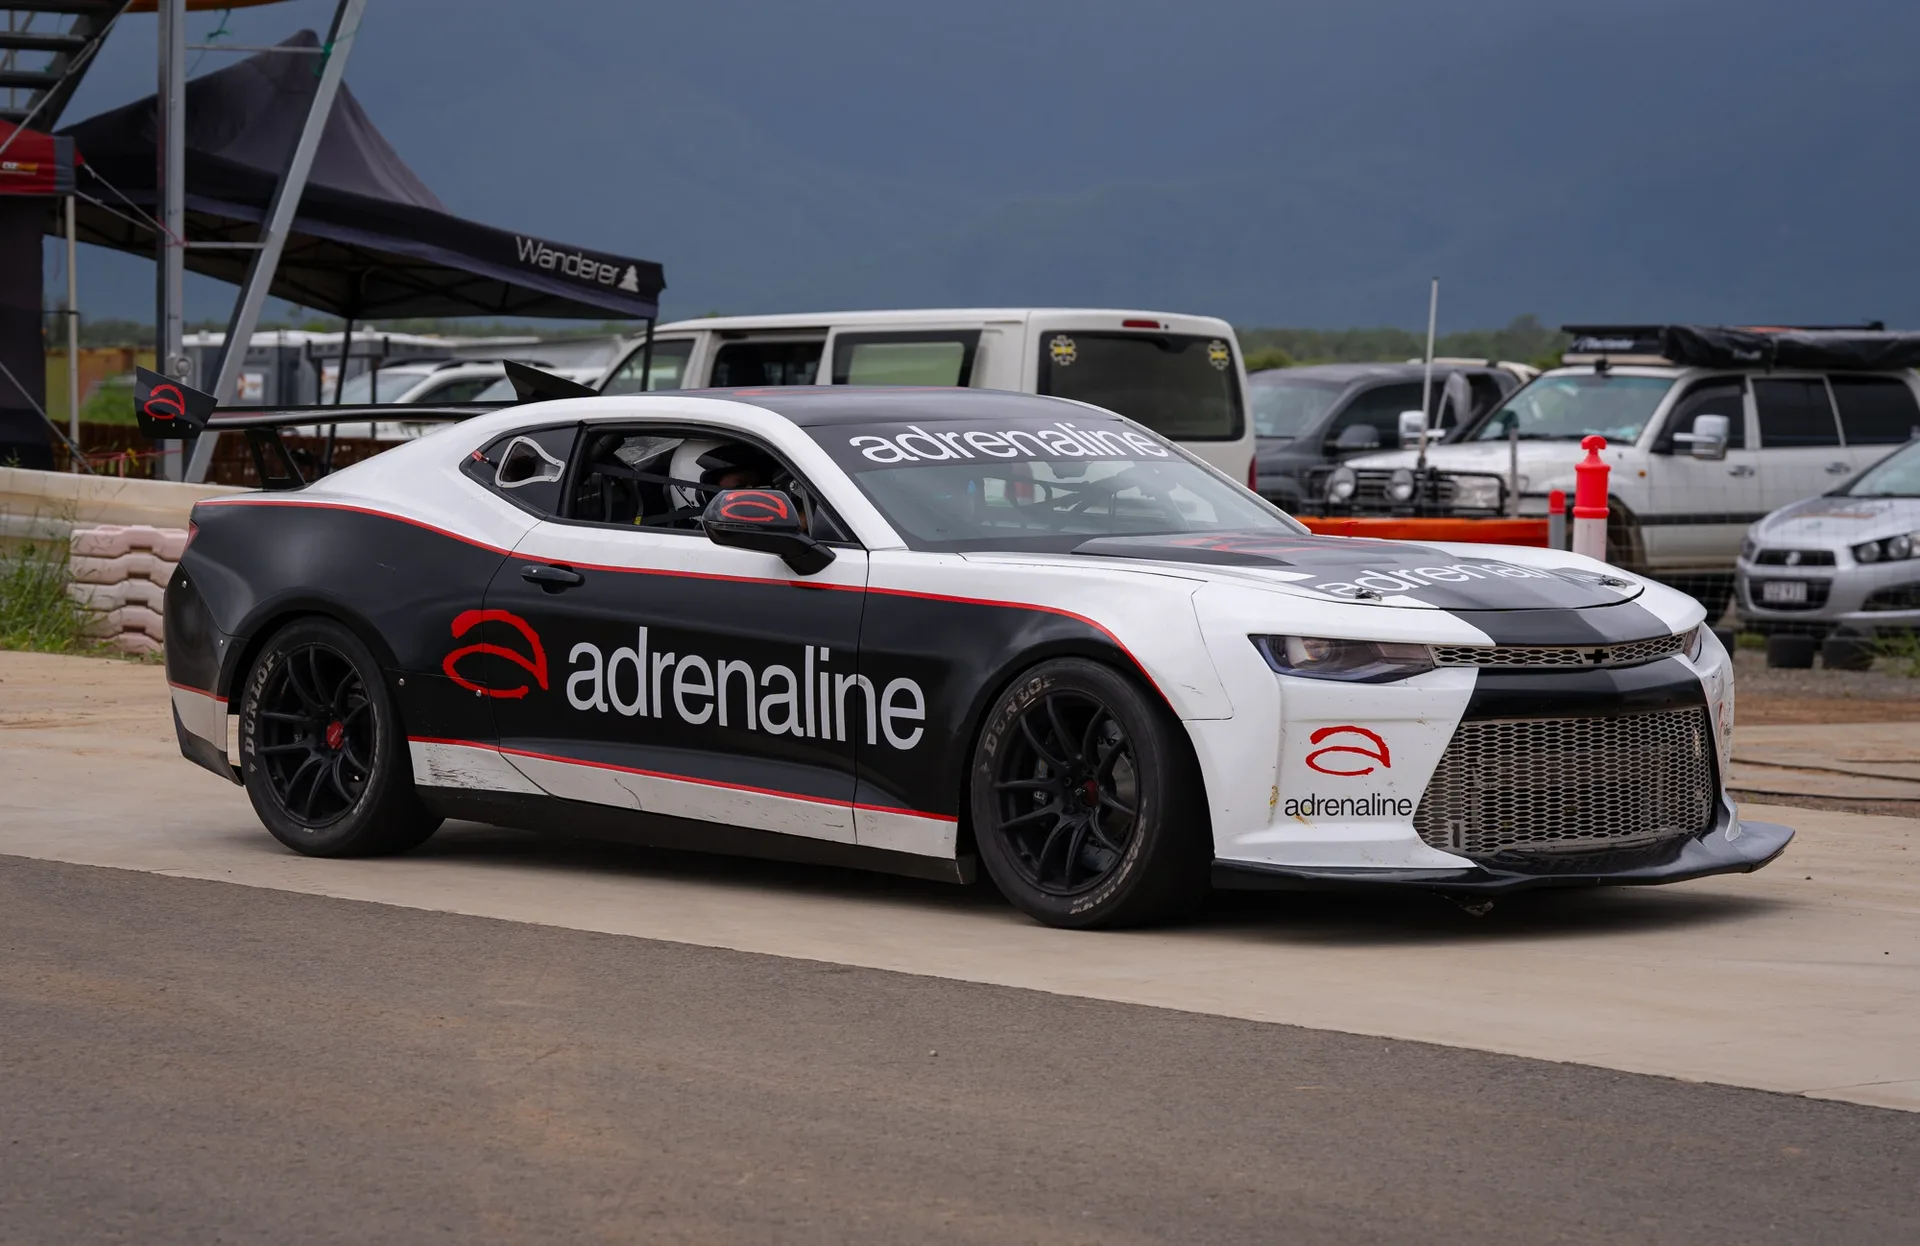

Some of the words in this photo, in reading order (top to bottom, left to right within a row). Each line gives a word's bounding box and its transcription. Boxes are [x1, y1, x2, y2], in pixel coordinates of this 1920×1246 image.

[515, 235, 620, 286] Wanderer
[849, 422, 1169, 463] adrenaline
[566, 626, 926, 750] adrenaline
[1284, 793, 1412, 816] adrenaline
